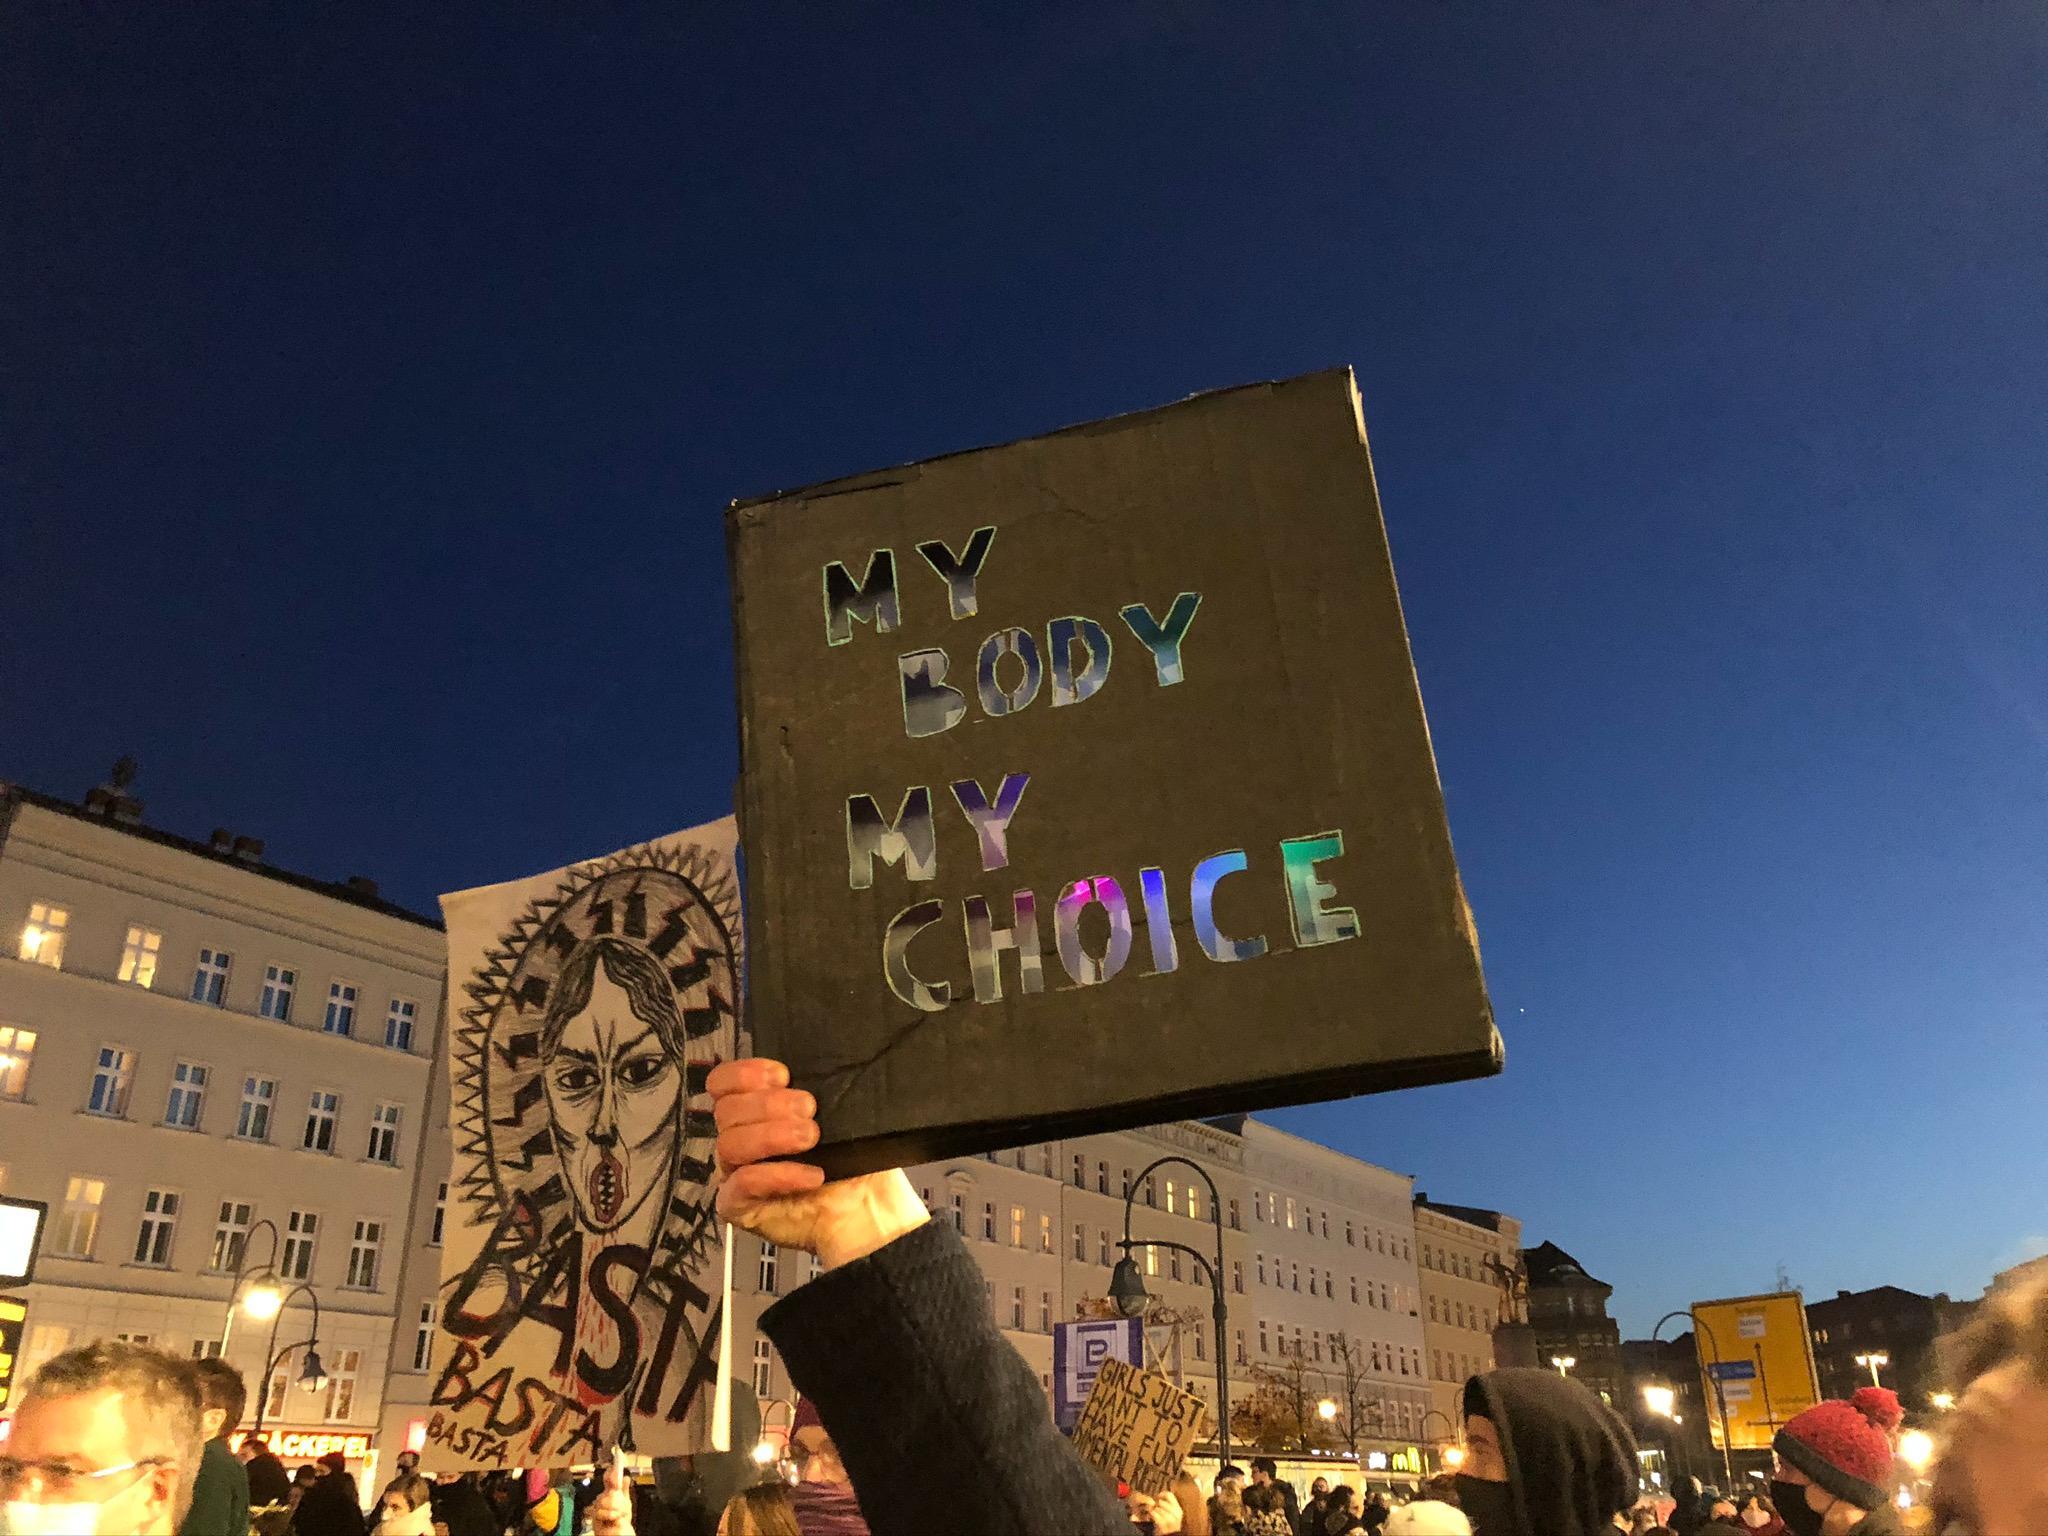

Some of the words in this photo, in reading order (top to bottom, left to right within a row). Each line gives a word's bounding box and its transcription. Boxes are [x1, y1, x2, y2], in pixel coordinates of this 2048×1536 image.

[822, 525, 998, 648] MY
[898, 592, 1202, 739] BODY
[846, 771, 1031, 890] MY
[881, 829, 1362, 1012] CHOICE
[426, 1411, 509, 1467] BASTA
[429, 1340, 603, 1463] BASTA
[1081, 1404, 1134, 1447] HAVE
[1138, 1434, 1184, 1476] FUN
[1101, 1358, 1151, 1399] GIRLS
[1151, 1380, 1205, 1428] JUST
[1153, 1409, 1183, 1446] TO
[257, 1430, 368, 1458] ÄCKEREI
